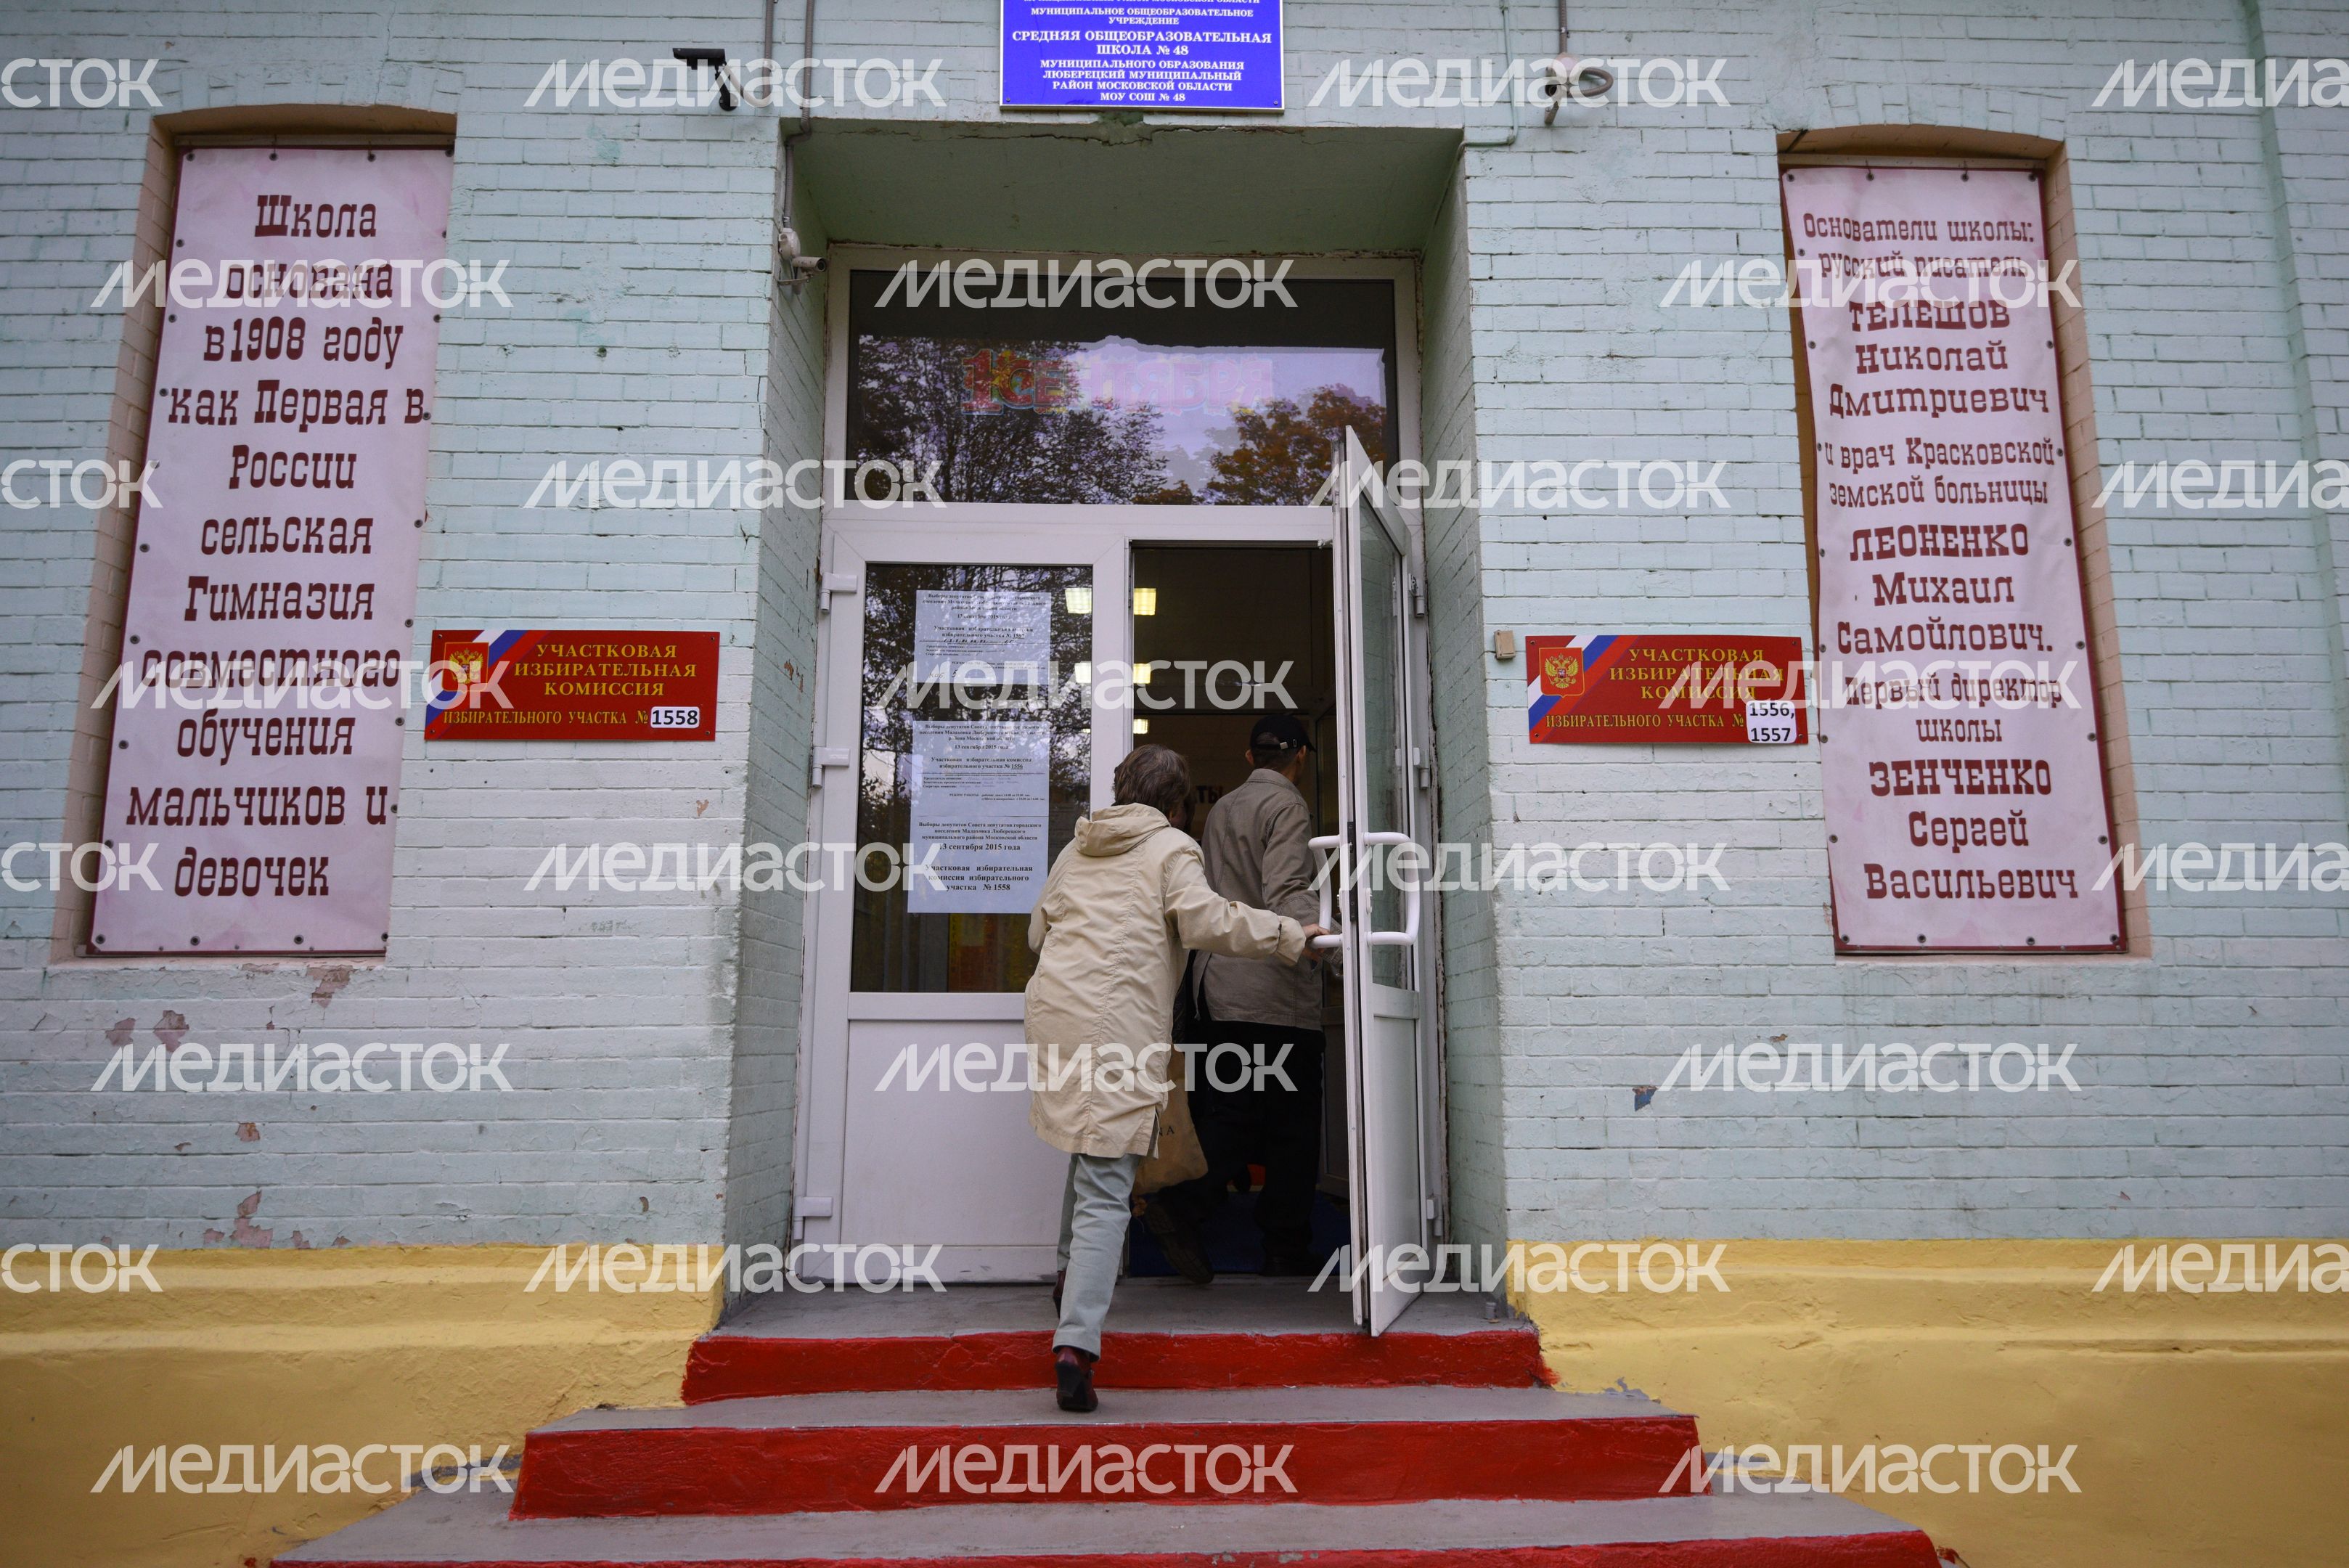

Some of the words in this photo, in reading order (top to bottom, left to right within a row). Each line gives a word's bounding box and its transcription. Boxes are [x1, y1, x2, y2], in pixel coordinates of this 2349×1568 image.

[1012, 30, 1080, 43] СРЕДНЯЯ
[1084, 31, 1272, 44] ОБЩЕОБРАЗОВАТЕЛЬНАЯ
[1096, 45, 1152, 55] ШКОЛА
[1156, 45, 1170, 55] №
[1172, 45, 1189, 55] 48
[1040, 60, 1157, 69] МУНИЦИПАЛЬНОГО
[1159, 60, 1244, 70] ОБРАЗОВАНИЯ
[1043, 69, 1125, 80] ЛЮБЕРЕЦКИЙ
[1129, 70, 1242, 81] МУНИЦИПАЛЬНЫЙ
[1053, 79, 1093, 89] РАЙОН
[1096, 79, 1174, 90] МОСКОВСКОЙ
[1177, 82, 1232, 91] ОБЛАСТИ
[1100, 93, 1125, 102] МОУ
[1129, 93, 1155, 102] СОШ
[1159, 93, 1169, 102] №
[1172, 93, 1185, 102] 48
[254, 195, 377, 237] Школа
[1803, 213, 1937, 242] Основатели
[1947, 221, 2034, 242] школы:
[226, 262, 393, 299] основана
[1818, 250, 1905, 279] русский
[1914, 255, 2029, 279] писатель
[1849, 299, 2010, 332] ТЕЛЕШОВ
[322, 317, 404, 369] году
[1856, 340, 2008, 374] Николай
[168, 388, 238, 425] как
[254, 380, 387, 433] Первая
[404, 388, 425, 425] в
[1829, 383, 2048, 419] Дмитриевич
[228, 444, 357, 489] России
[1825, 442, 1834, 465] и
[1840, 442, 1895, 474] врач
[1905, 437, 2054, 469] Красковской
[1829, 475, 1924, 507] земской
[1935, 475, 2048, 505] больницы
[200, 516, 373, 555] сельская
[1850, 523, 2028, 561] ЛЕОНЕНКО
[184, 576, 375, 621] Гимназия
[1873, 571, 2014, 606] Михаил
[536, 643, 677, 658] УЧАСТКОВАЯ
[1837, 616, 2054, 654] Самойлович.
[142, 648, 401, 687] совместного
[514, 663, 697, 677] ИЗБИРАТЕЛЬНАЯ
[1630, 648, 1764, 663] УЧАСТКОВАЯ
[544, 682, 664, 696] КОМИССИЯ
[1609, 667, 1784, 682] ИЗБИРАТЕЛЬНАЯ
[1641, 685, 1757, 700] КОМИССИЯ
[443, 711, 562, 724] ИЗБИРАТЕЛЬНОГО
[568, 711, 627, 724] УЧАСТКА
[635, 711, 649, 724] №
[652, 709, 698, 726] 1558
[1546, 714, 1661, 727] ИЗБИРАТЕЛЬНОГО
[1668, 714, 1725, 727] УЧАСТКА
[1749, 701, 1795, 719] 1556,
[1916, 718, 2003, 743] школы
[176, 709, 355, 766] обучения
[1750, 727, 1791, 743] 1557
[1869, 759, 2051, 796] ЗЕНЧЕНКО
[126, 785, 345, 826] мальчиков
[366, 785, 388, 825] и
[1908, 809, 2029, 853] Сергей
[174, 847, 329, 897] девочек
[969, 874, 1029, 883] избирательного
[1864, 863, 2078, 899] Васильевич
